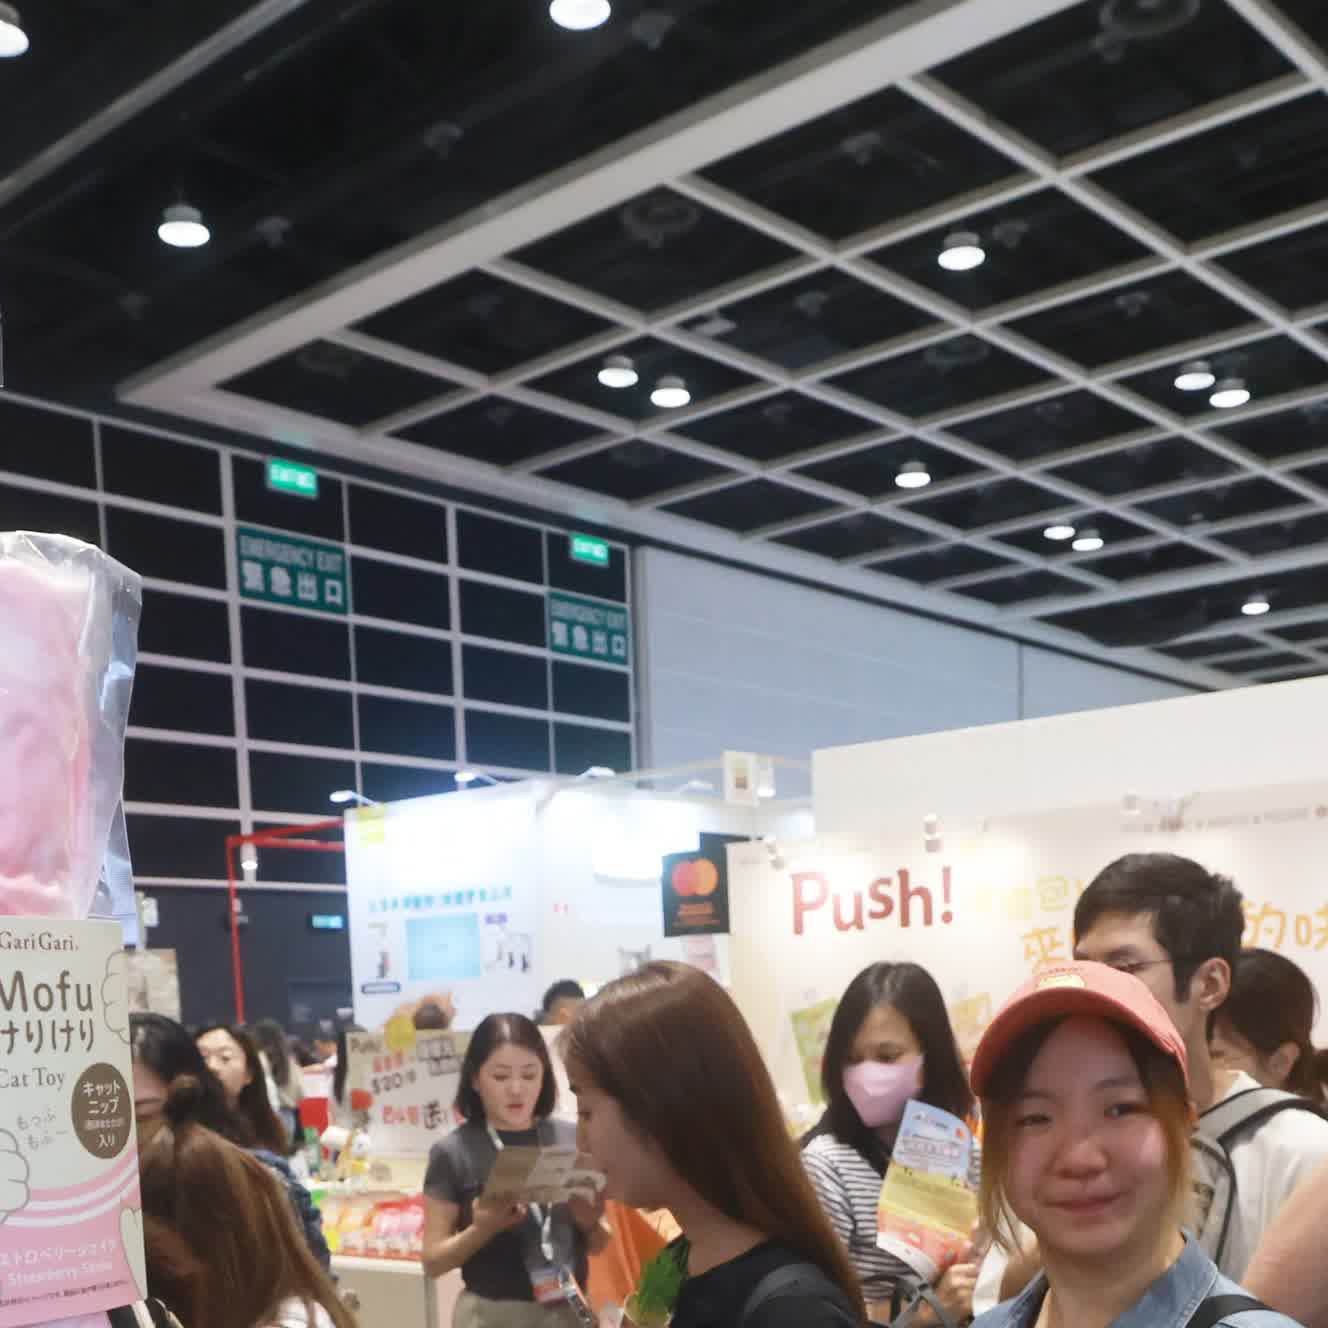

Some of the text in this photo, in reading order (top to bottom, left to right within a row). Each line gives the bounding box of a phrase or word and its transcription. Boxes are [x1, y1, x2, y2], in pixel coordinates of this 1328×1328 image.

[789, 864, 954, 936] Push!
[32, 1066, 66, 1092] Toy
[83, 1079, 122, 1097] キャット
[88, 1096, 120, 1115] ニップ
[97, 1133, 116, 1149] 入り
